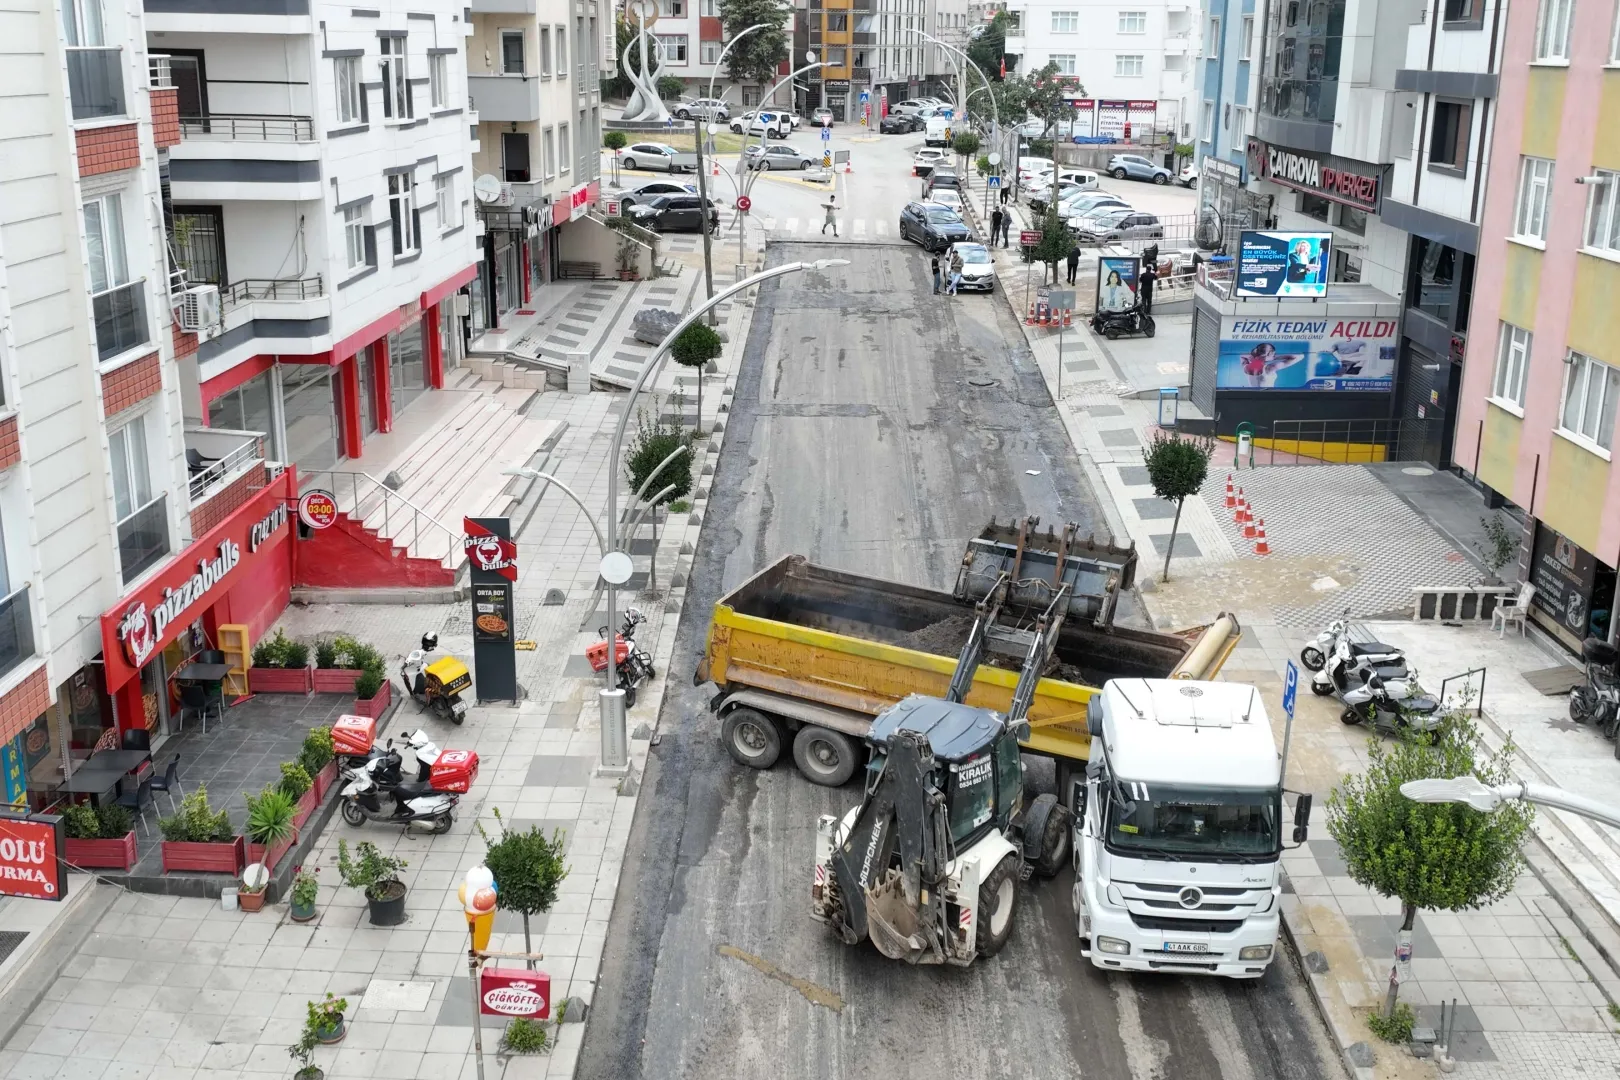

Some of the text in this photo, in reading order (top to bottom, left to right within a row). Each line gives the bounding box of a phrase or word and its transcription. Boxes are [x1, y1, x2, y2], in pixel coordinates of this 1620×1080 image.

[1269, 151, 1319, 187] ÇAYIROVA
[1321, 166, 1335, 189] TIP
[1335, 173, 1377, 202] MERKEZİ
[608, 203, 617, 213] E
[1232, 319, 1396, 342] FİZİK TEDAVİ AÇILDI
[464, 536, 499, 548] pizza
[482, 560, 509, 571] bulls
[1543, 553, 1561, 572] JOKER
[152, 538, 240, 642] pizzabulls
[121, 602, 145, 640] pizza
[1177, 943, 1191, 951] AAK
[488, 990, 540, 1005] ÇİĞKÖFTE
[495, 1004, 533, 1012] DÜNYASI
